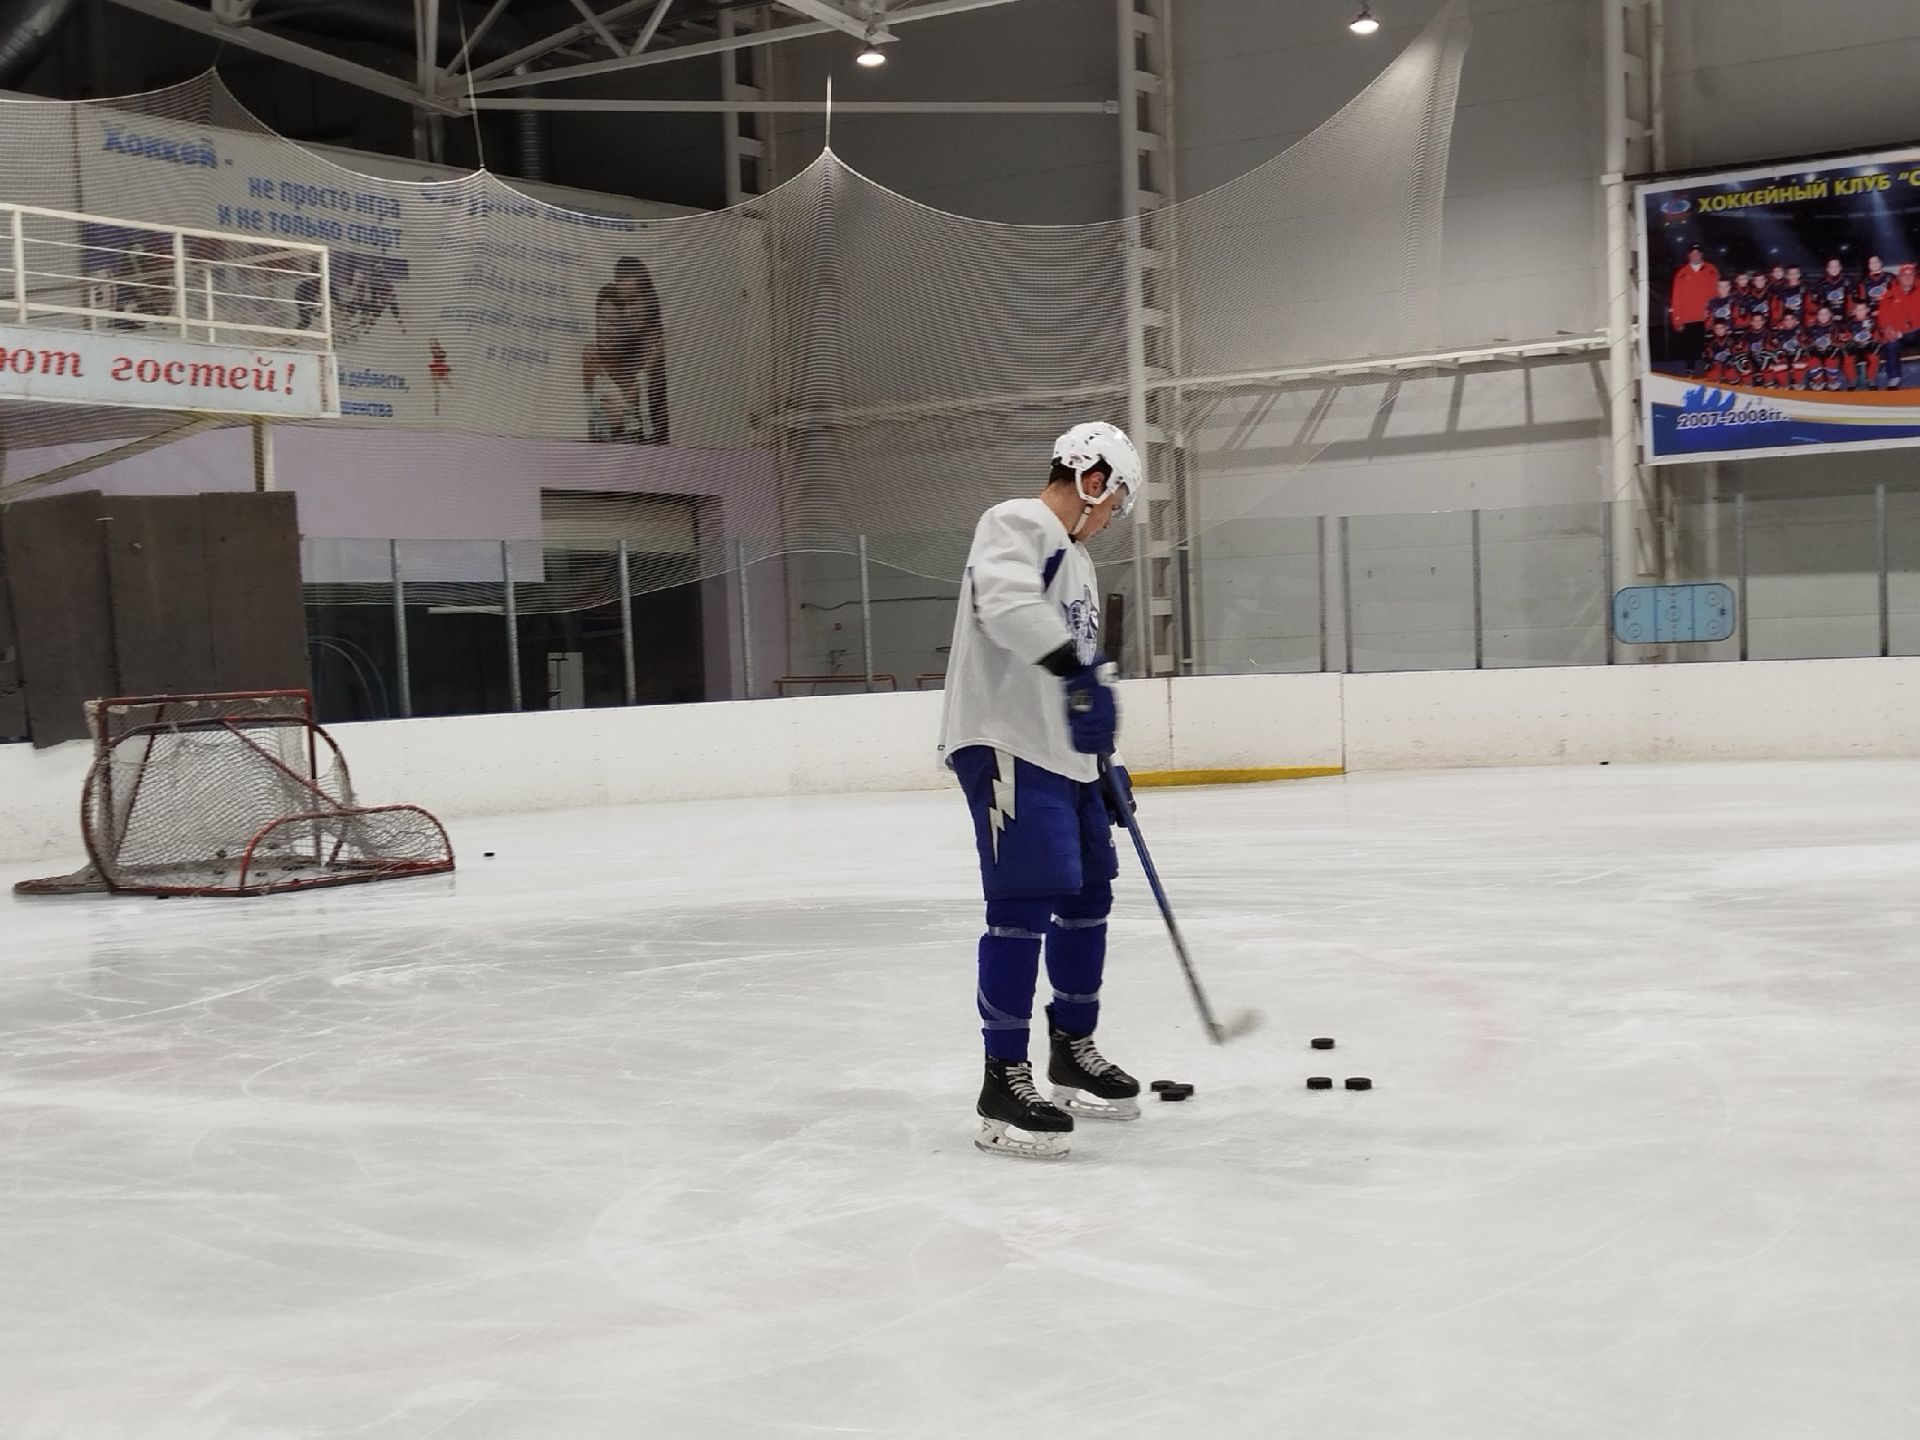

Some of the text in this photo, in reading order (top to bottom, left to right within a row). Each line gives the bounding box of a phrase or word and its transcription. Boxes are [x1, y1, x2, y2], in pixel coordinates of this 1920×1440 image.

[248, 175, 274, 200] не
[280, 181, 351, 211] просто
[1698, 179, 1828, 213] ХОККЕЙНЫЙ
[1834, 173, 1892, 196] КЛУБ
[237, 206, 263, 229] не
[270, 211, 342, 242] только
[110, 356, 297, 396] гостей!
